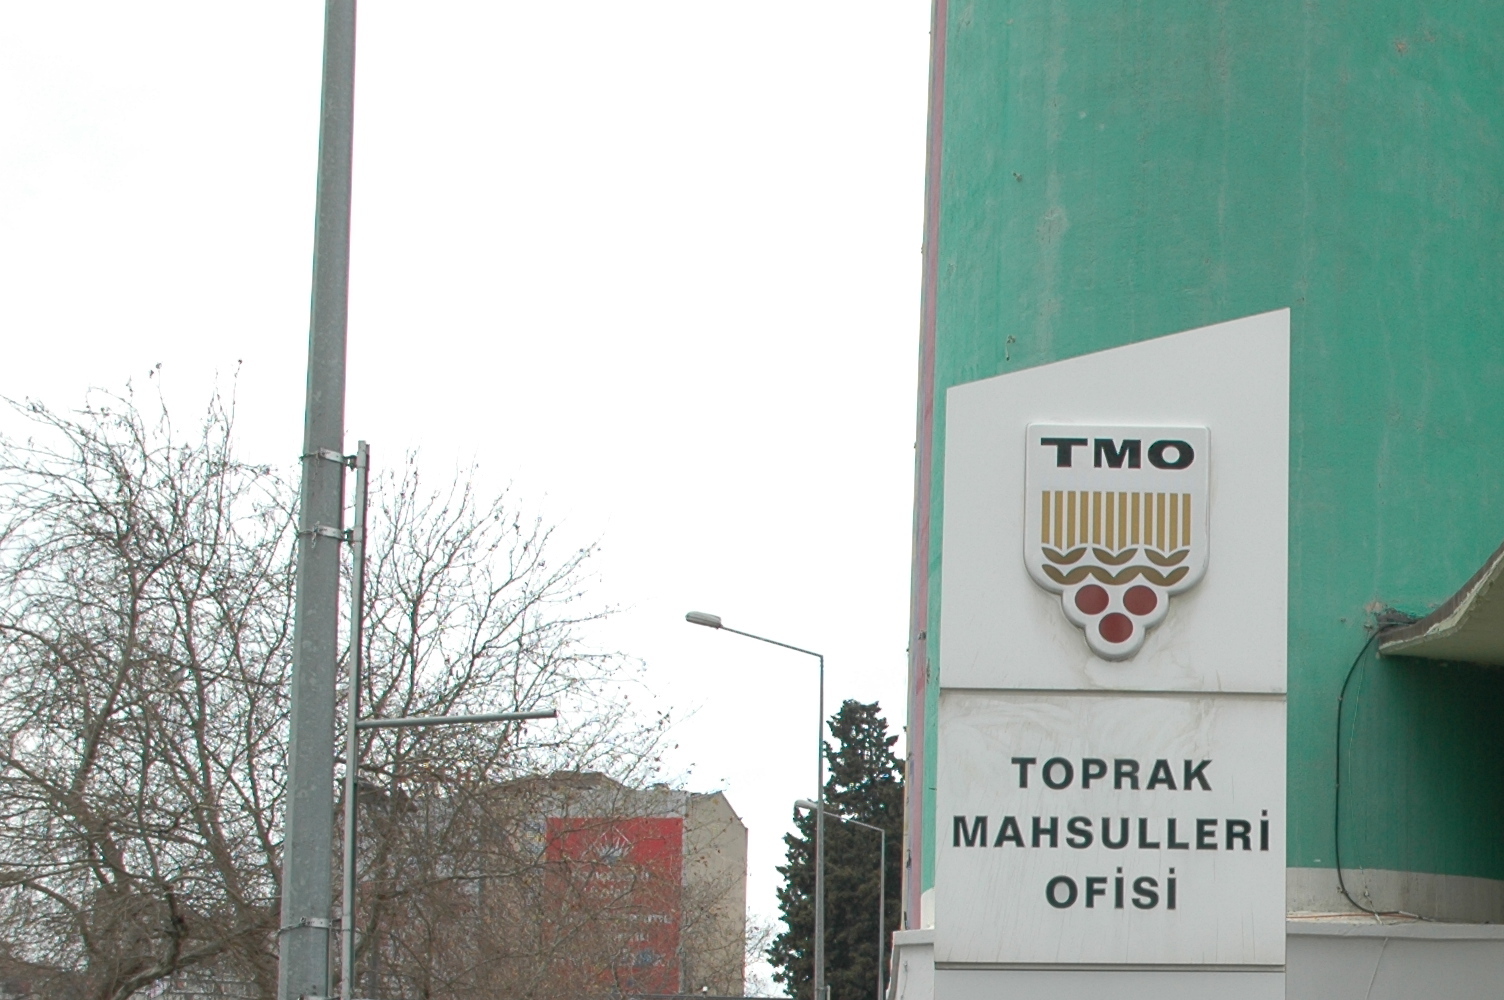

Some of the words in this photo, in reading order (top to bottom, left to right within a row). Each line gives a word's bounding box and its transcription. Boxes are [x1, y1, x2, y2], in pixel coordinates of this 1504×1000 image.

[1041, 437, 1195, 470] TMO
[1011, 756, 1213, 791] TOPRAK
[952, 809, 1270, 851] MAHSULLERİ
[1045, 866, 1177, 910] OFİSİ
